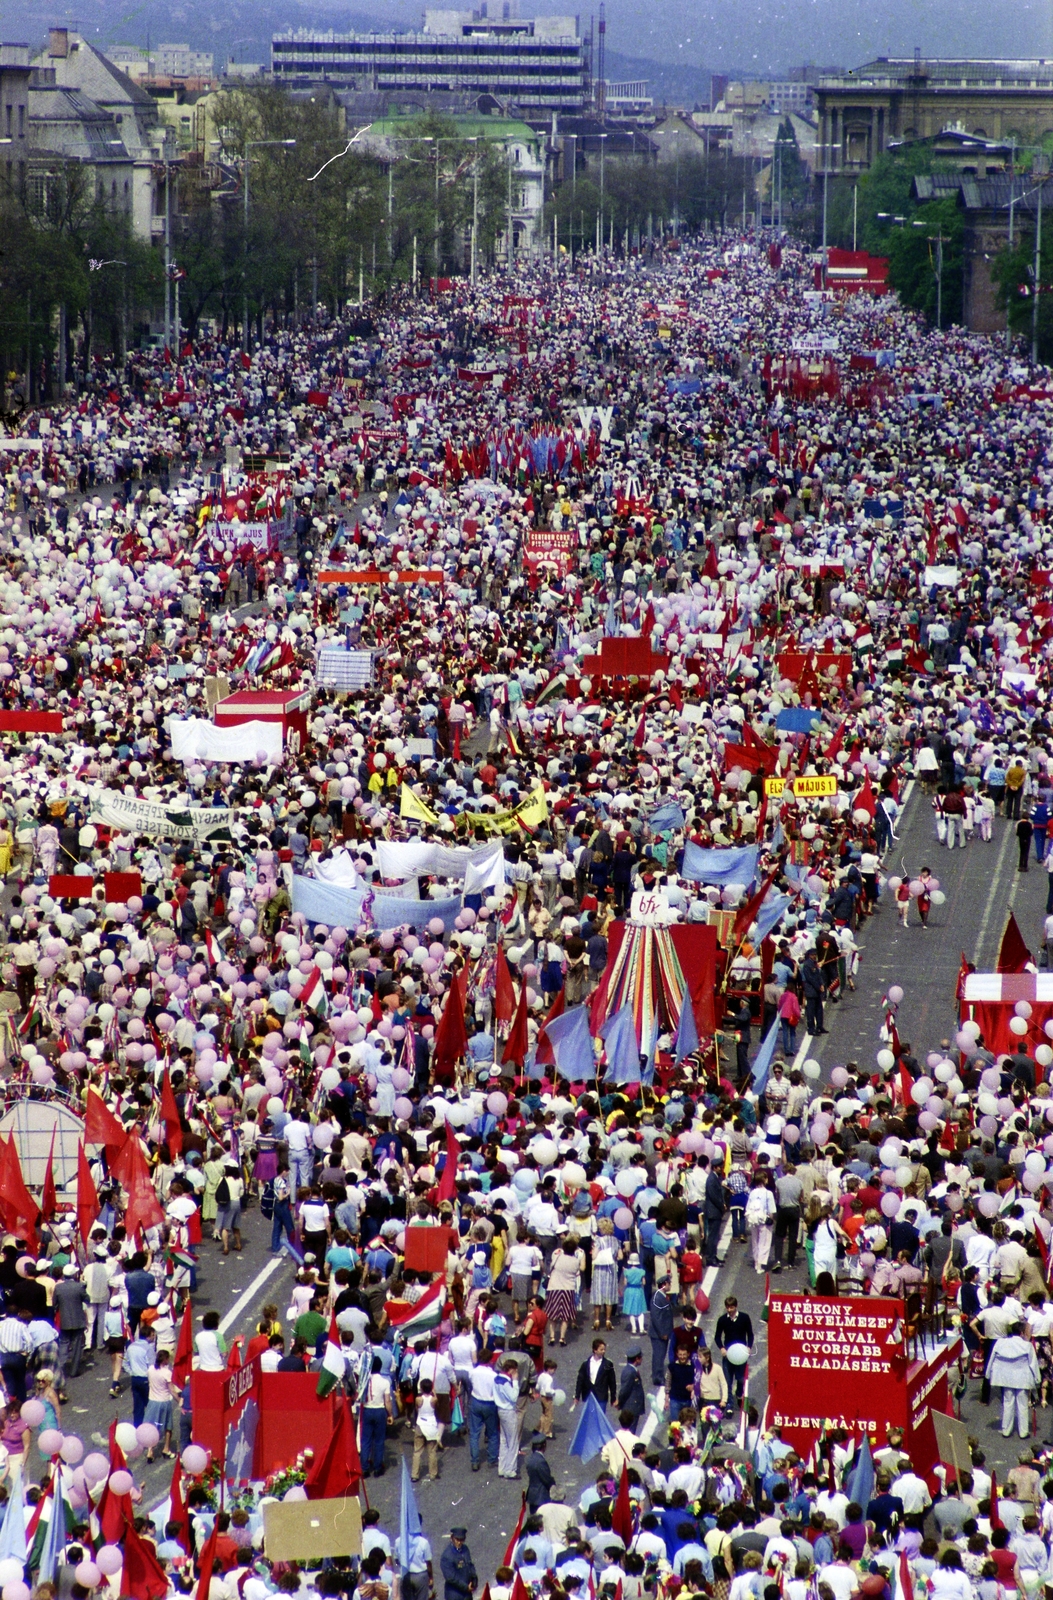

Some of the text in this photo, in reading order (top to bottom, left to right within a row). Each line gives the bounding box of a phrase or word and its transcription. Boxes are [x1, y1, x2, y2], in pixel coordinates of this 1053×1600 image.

[798, 780, 826, 793] MÁJUS
[772, 1300, 853, 1316] HATÉKONY
[790, 1355, 891, 1374] HALADÁSÉRT
